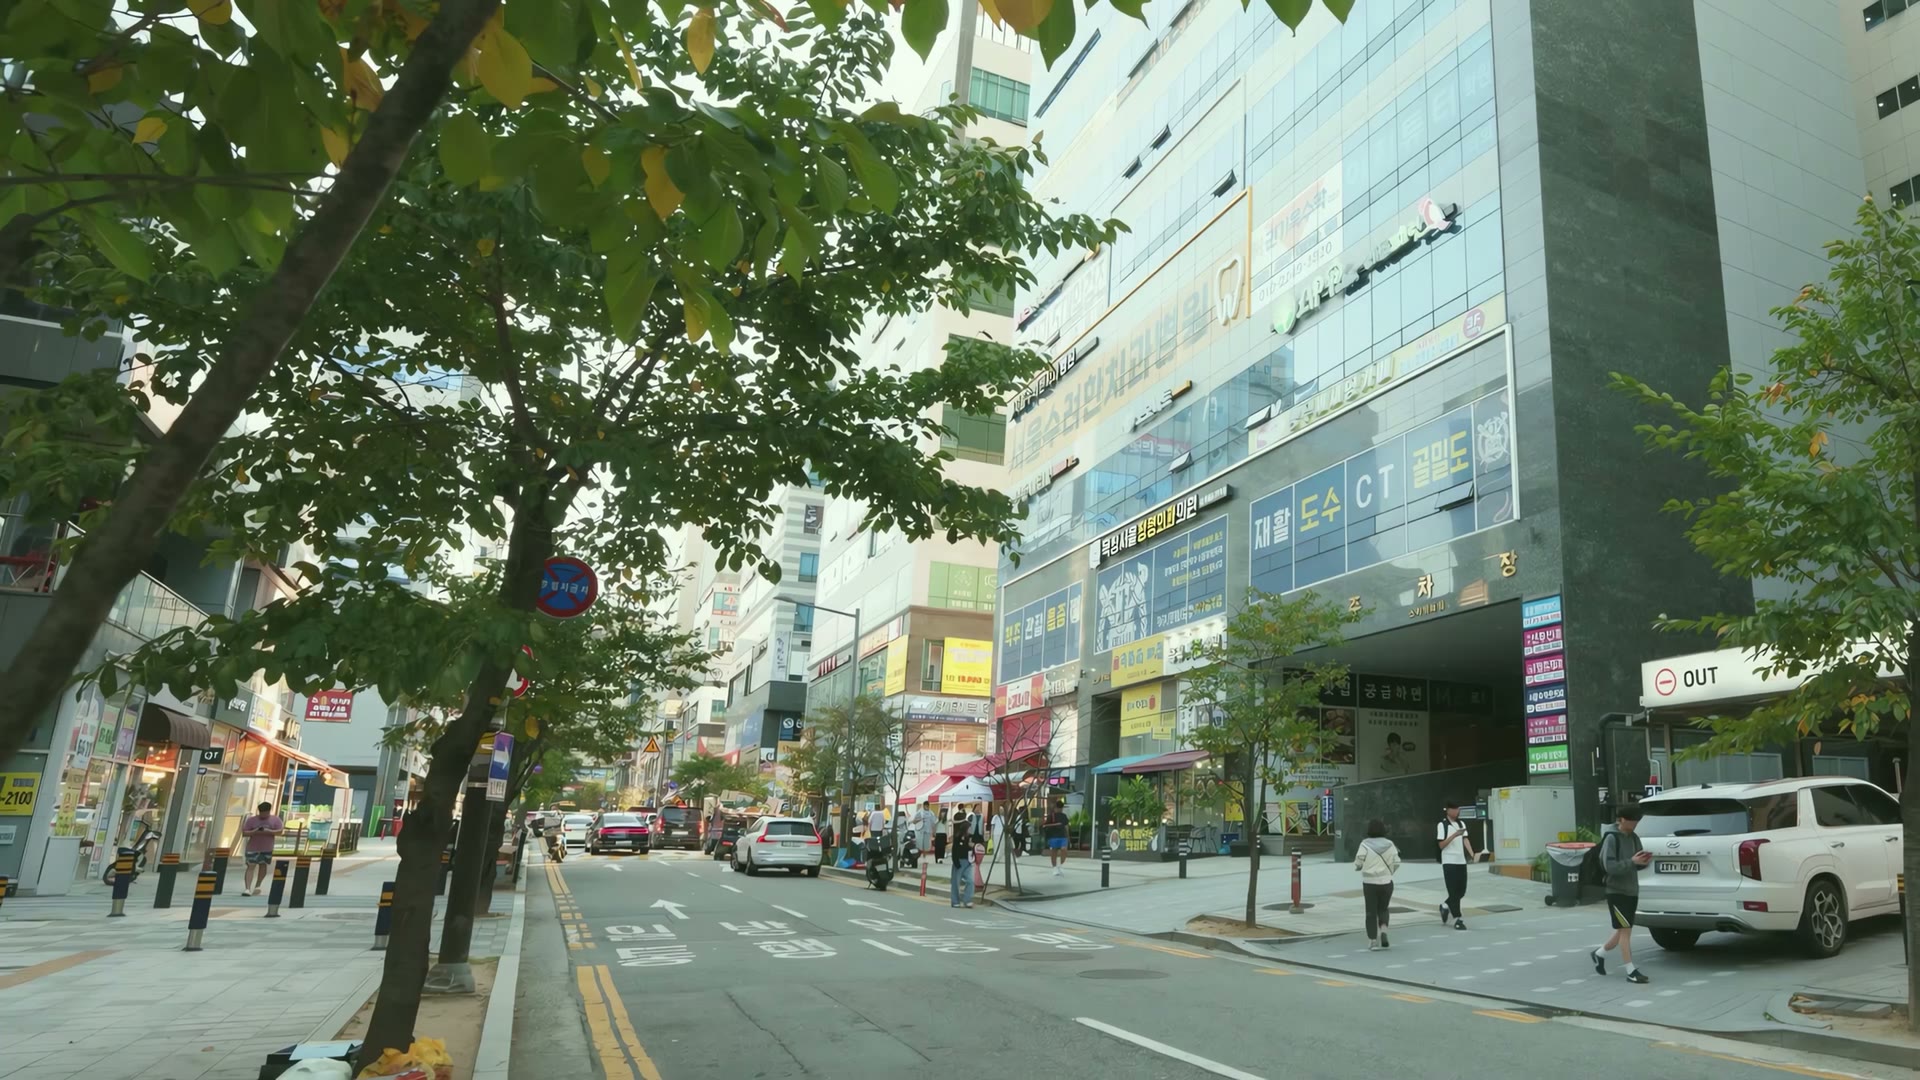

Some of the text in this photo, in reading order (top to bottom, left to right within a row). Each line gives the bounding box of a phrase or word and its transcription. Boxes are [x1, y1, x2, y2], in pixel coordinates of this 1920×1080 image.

[1254, 430, 1469, 550] 재활 도수 CT 골밀도
[1684, 667, 1718, 688] OUT
[1364, 683, 1422, 702] 궁금하면
